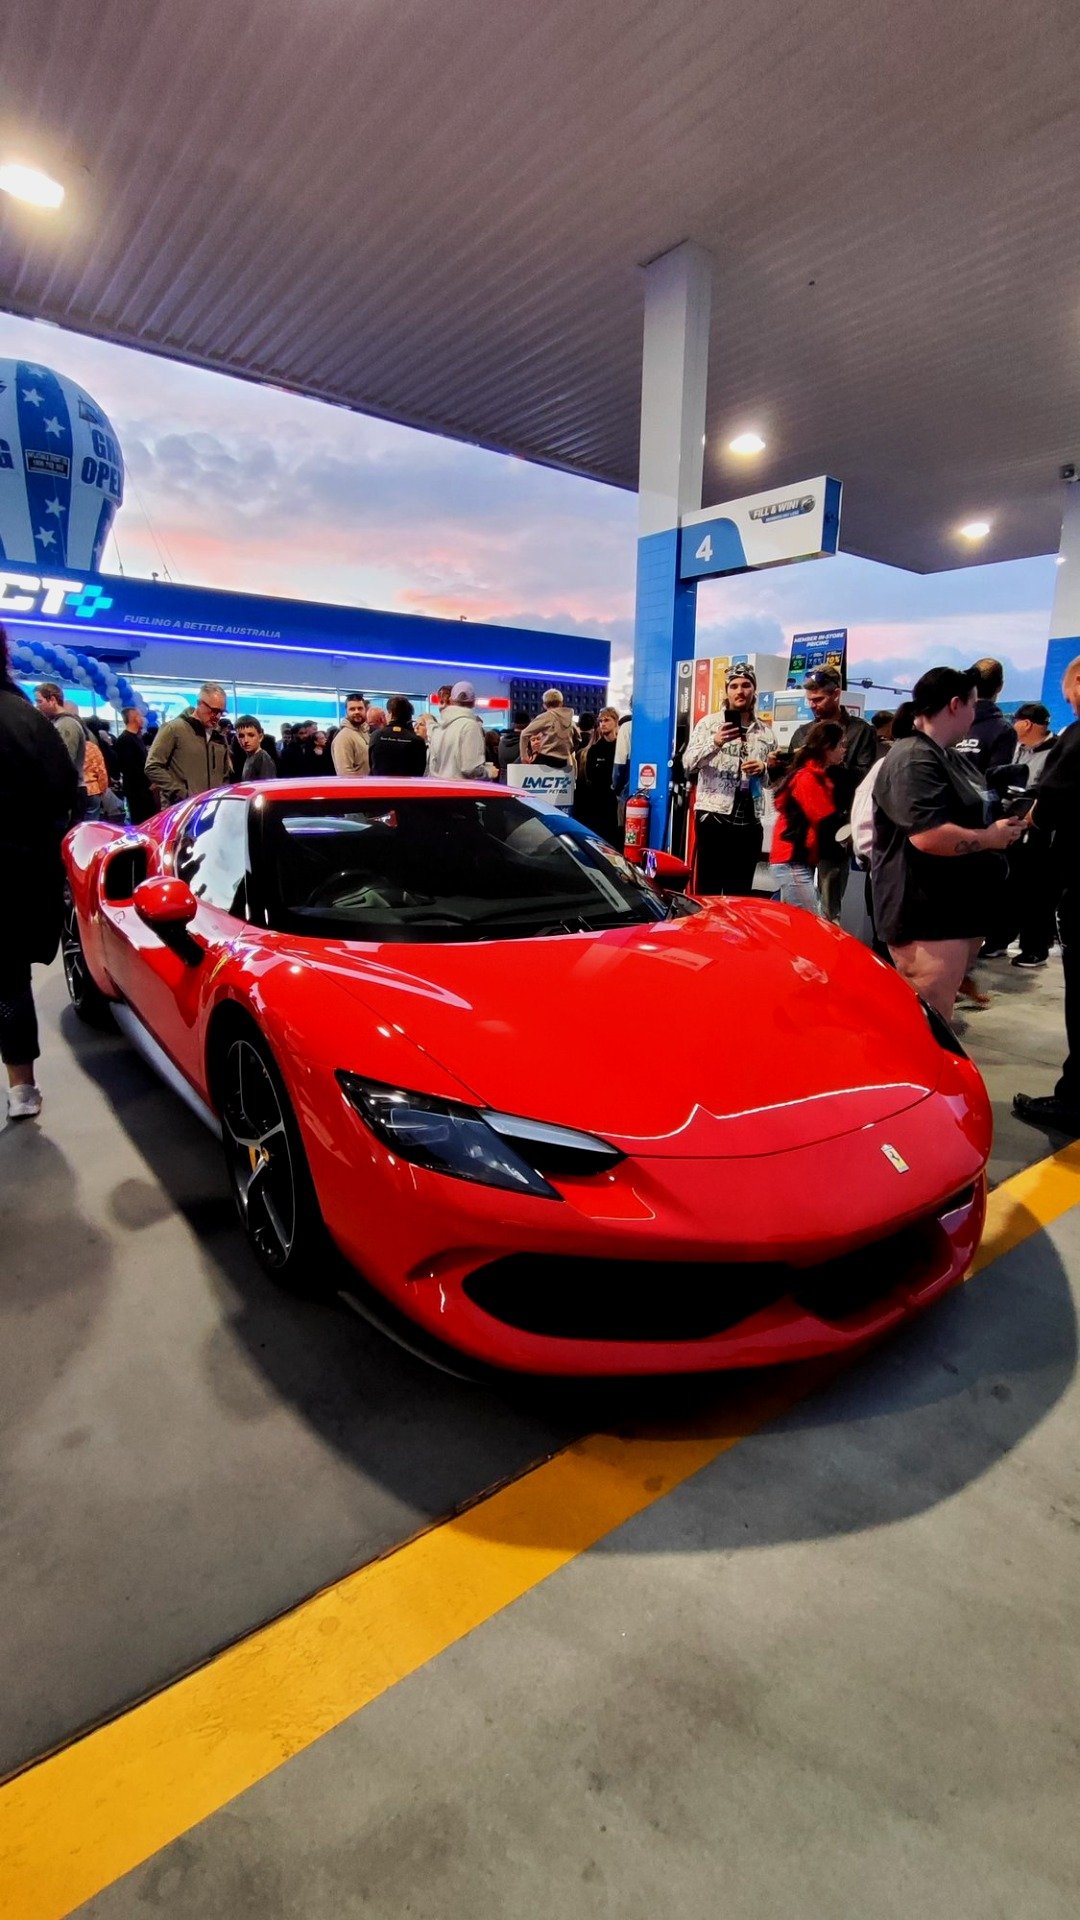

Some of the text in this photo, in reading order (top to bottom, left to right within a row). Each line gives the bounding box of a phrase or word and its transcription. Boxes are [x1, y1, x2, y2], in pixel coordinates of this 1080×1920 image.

[753, 505, 770, 519] FILL
[770, 503, 778, 514] &
[695, 534, 714, 562] 4
[123, 614, 281, 639] FUELING A BETTER AUSTRALIA
[794, 632, 845, 643] MEMBER IN-STORE
[806, 640, 829, 648] PRICING
[763, 694, 770, 702] 4
